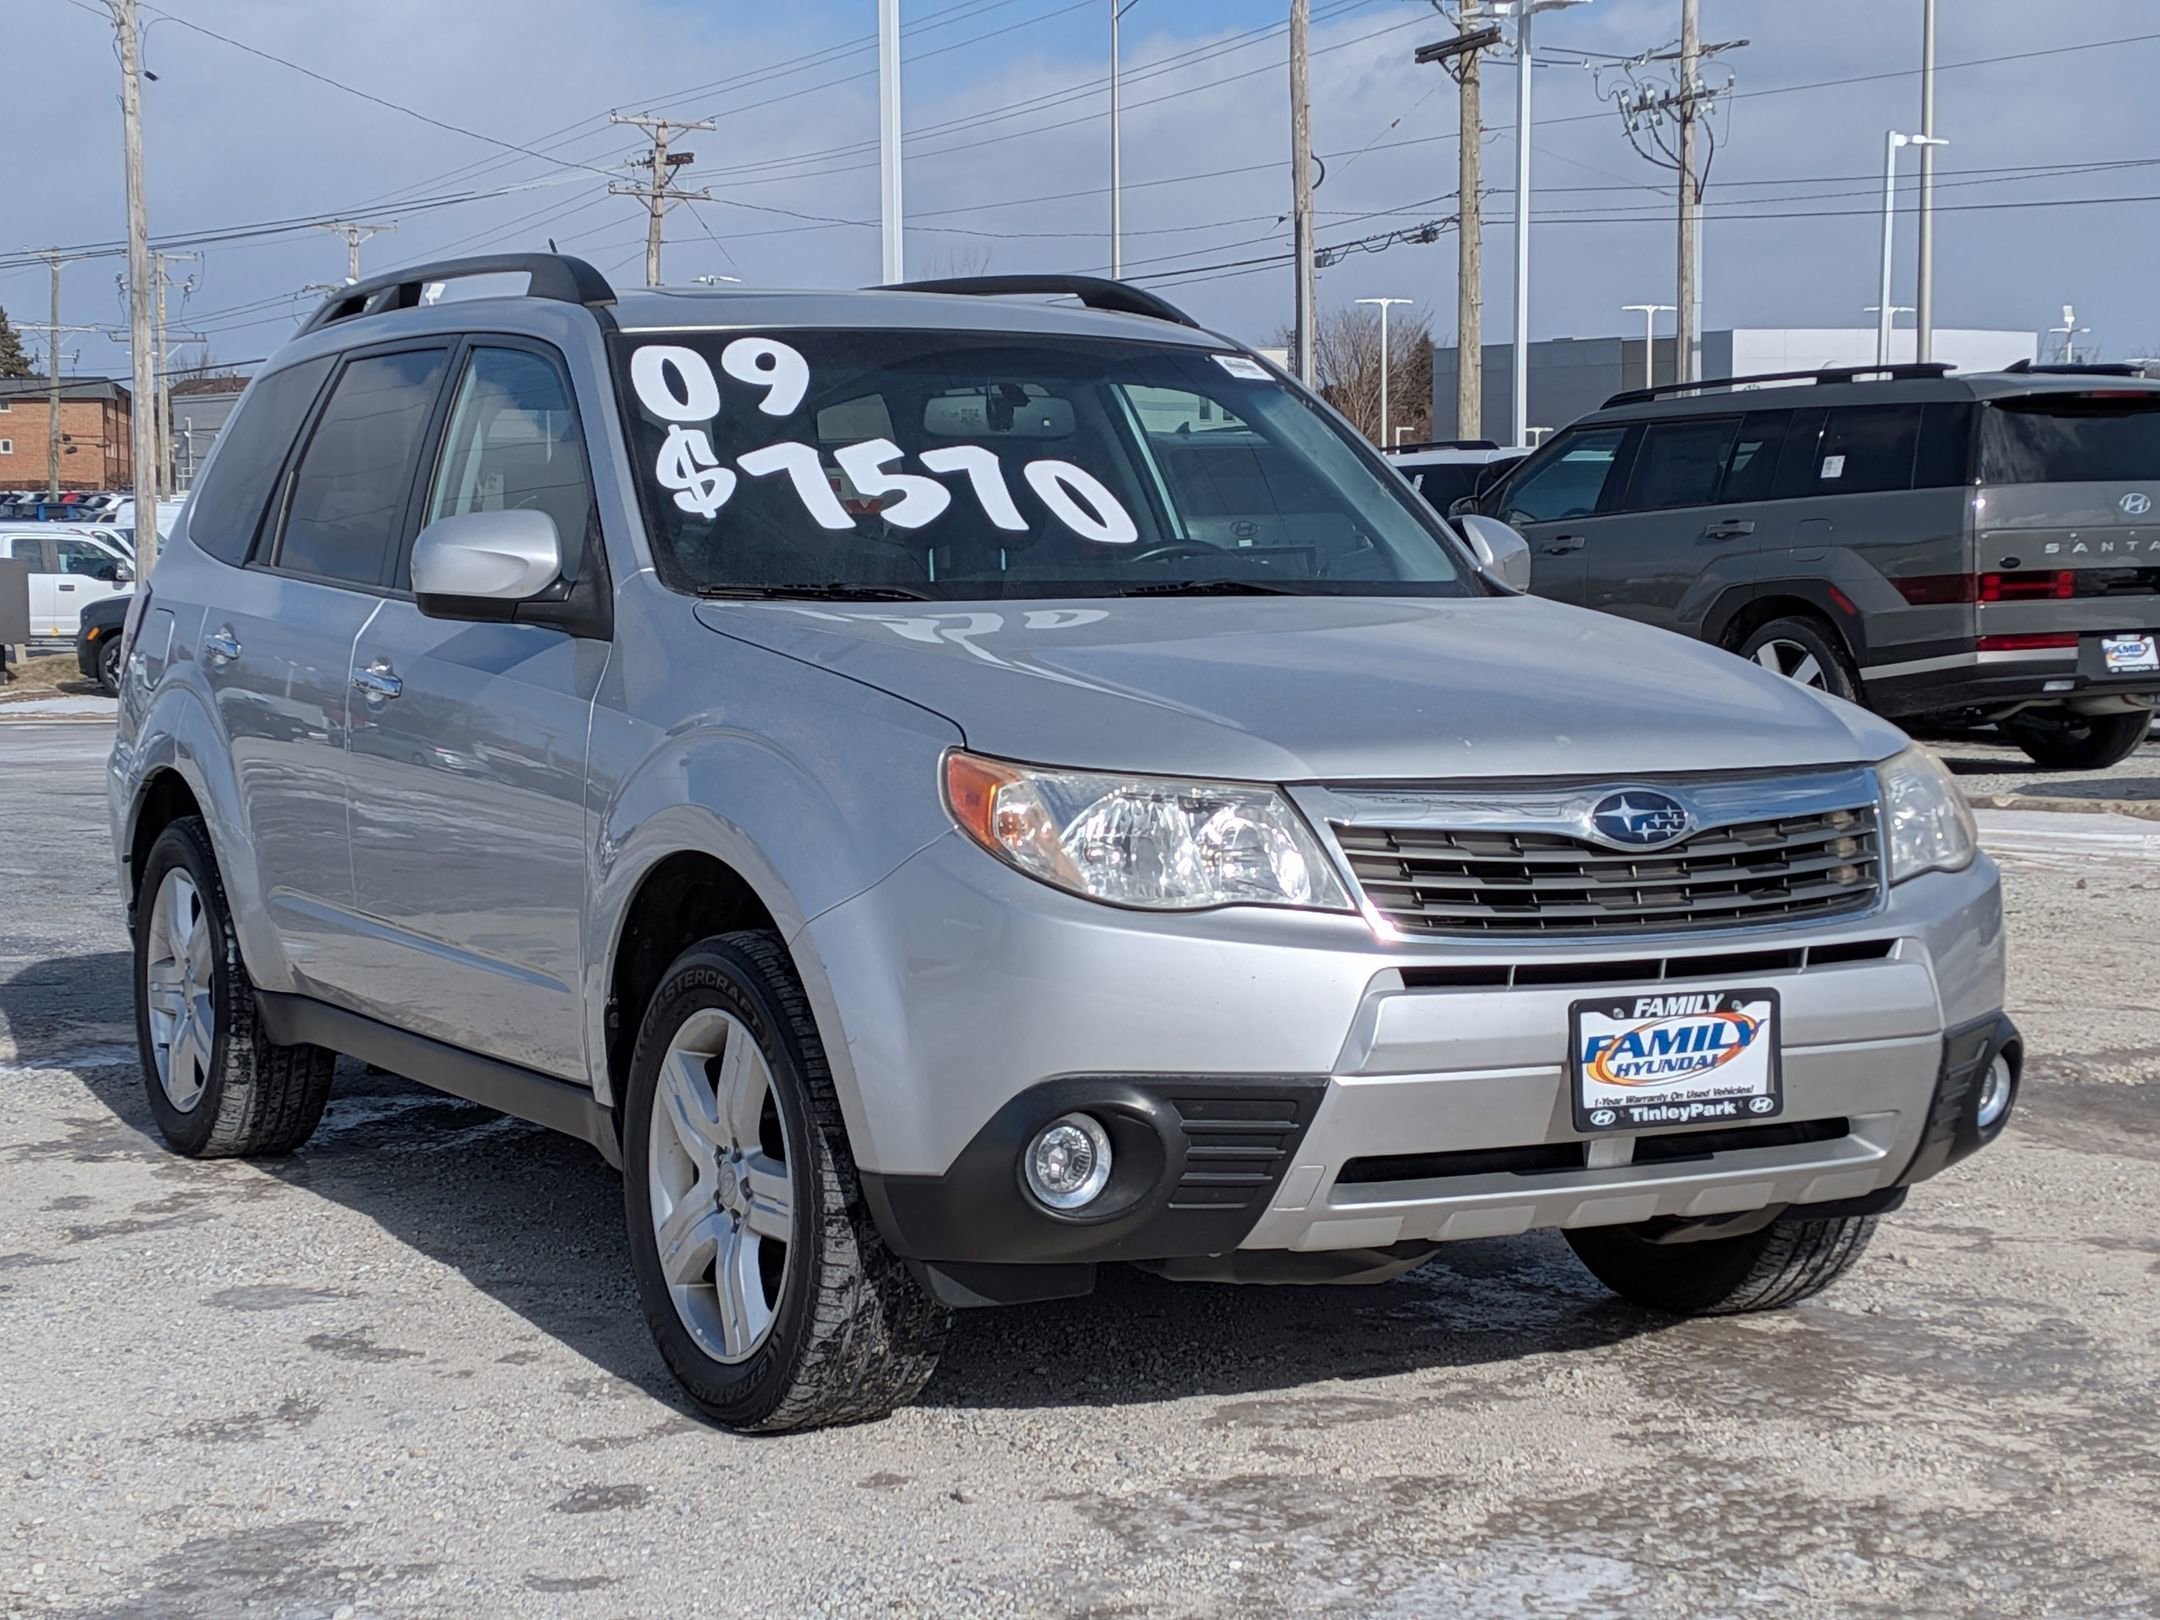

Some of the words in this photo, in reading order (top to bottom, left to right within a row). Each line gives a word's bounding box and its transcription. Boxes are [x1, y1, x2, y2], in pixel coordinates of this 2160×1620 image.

[630, 337, 810, 422] 09
[655, 424, 1139, 544] $7570
[2043, 540, 2160, 554] SANTA
[1632, 993, 1725, 1018] FAMILY
[1581, 1018, 1768, 1063] FAMILY
[1613, 1053, 1719, 1078] HYUNDAI
[1625, 1091, 1669, 1105] Warranty
[1686, 1088, 1711, 1099] Used
